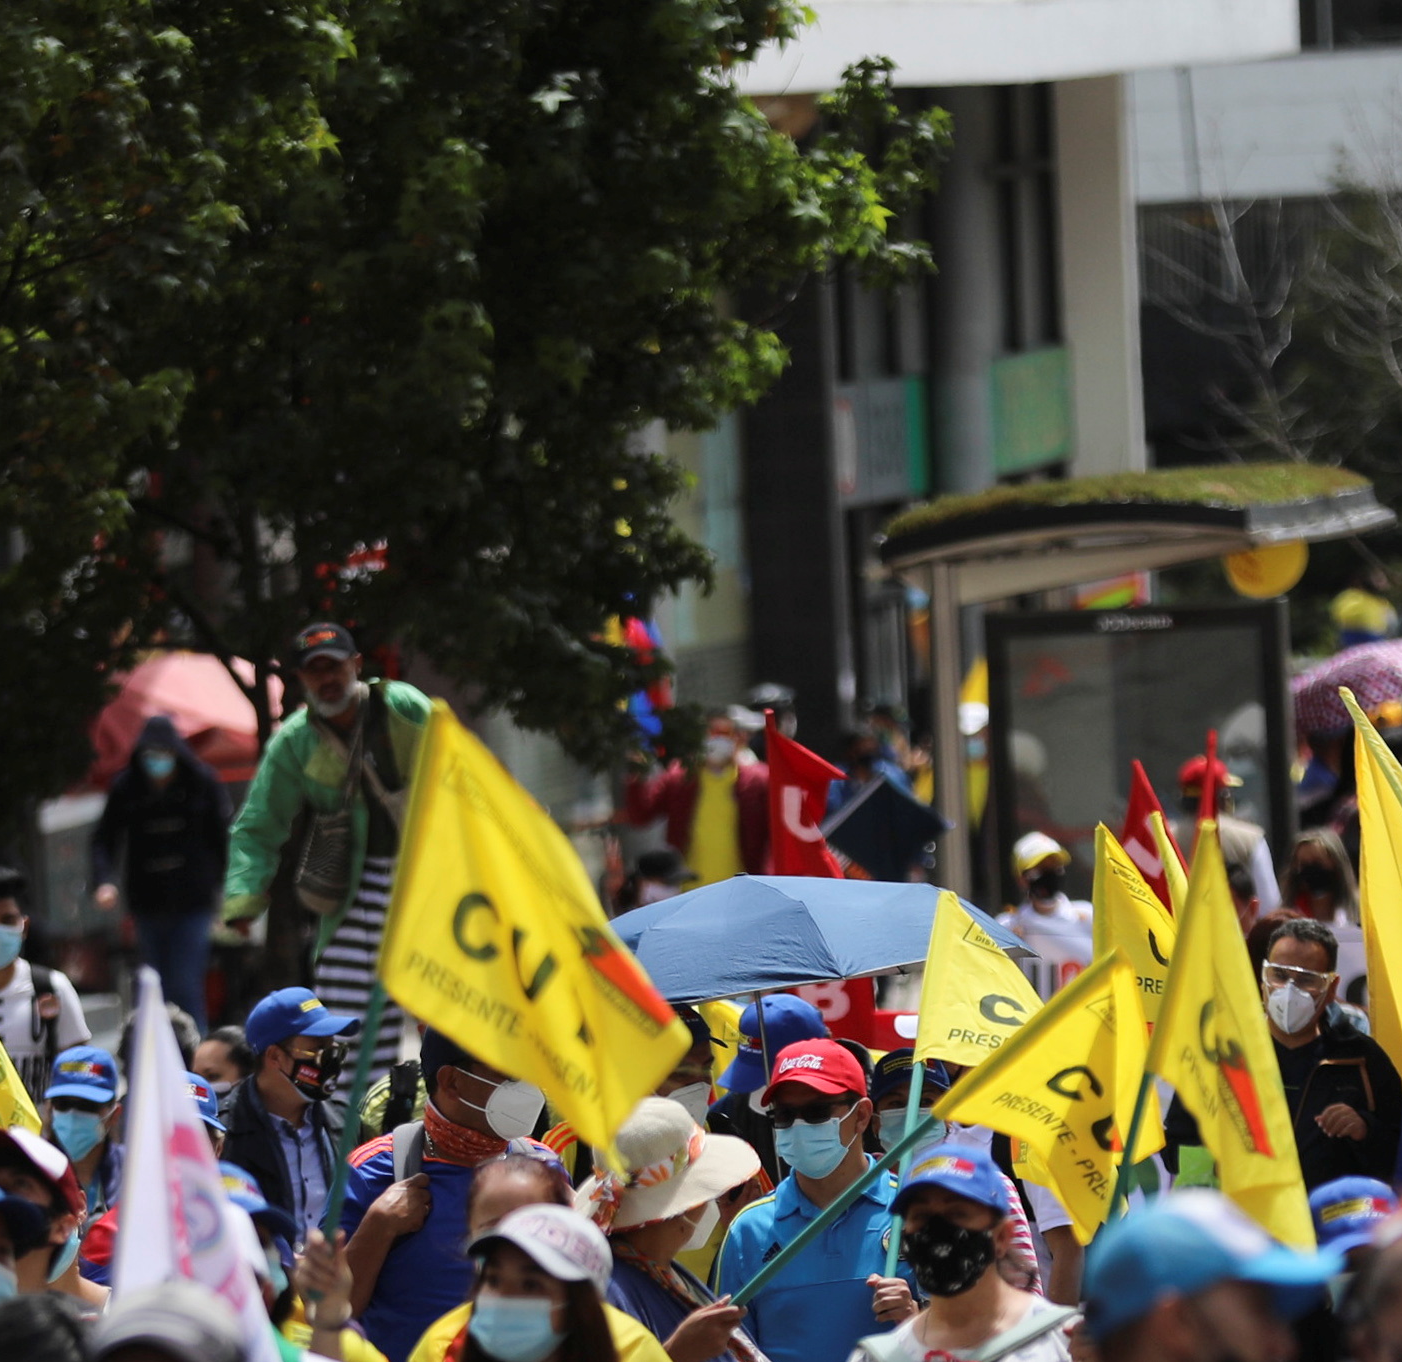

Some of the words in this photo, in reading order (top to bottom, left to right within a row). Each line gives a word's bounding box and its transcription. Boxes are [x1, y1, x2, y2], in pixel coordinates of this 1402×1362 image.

[407, 950, 526, 1038] PRESENTE
[947, 1027, 1011, 1050] PRES
[992, 1091, 1077, 1147] PRESENTE
